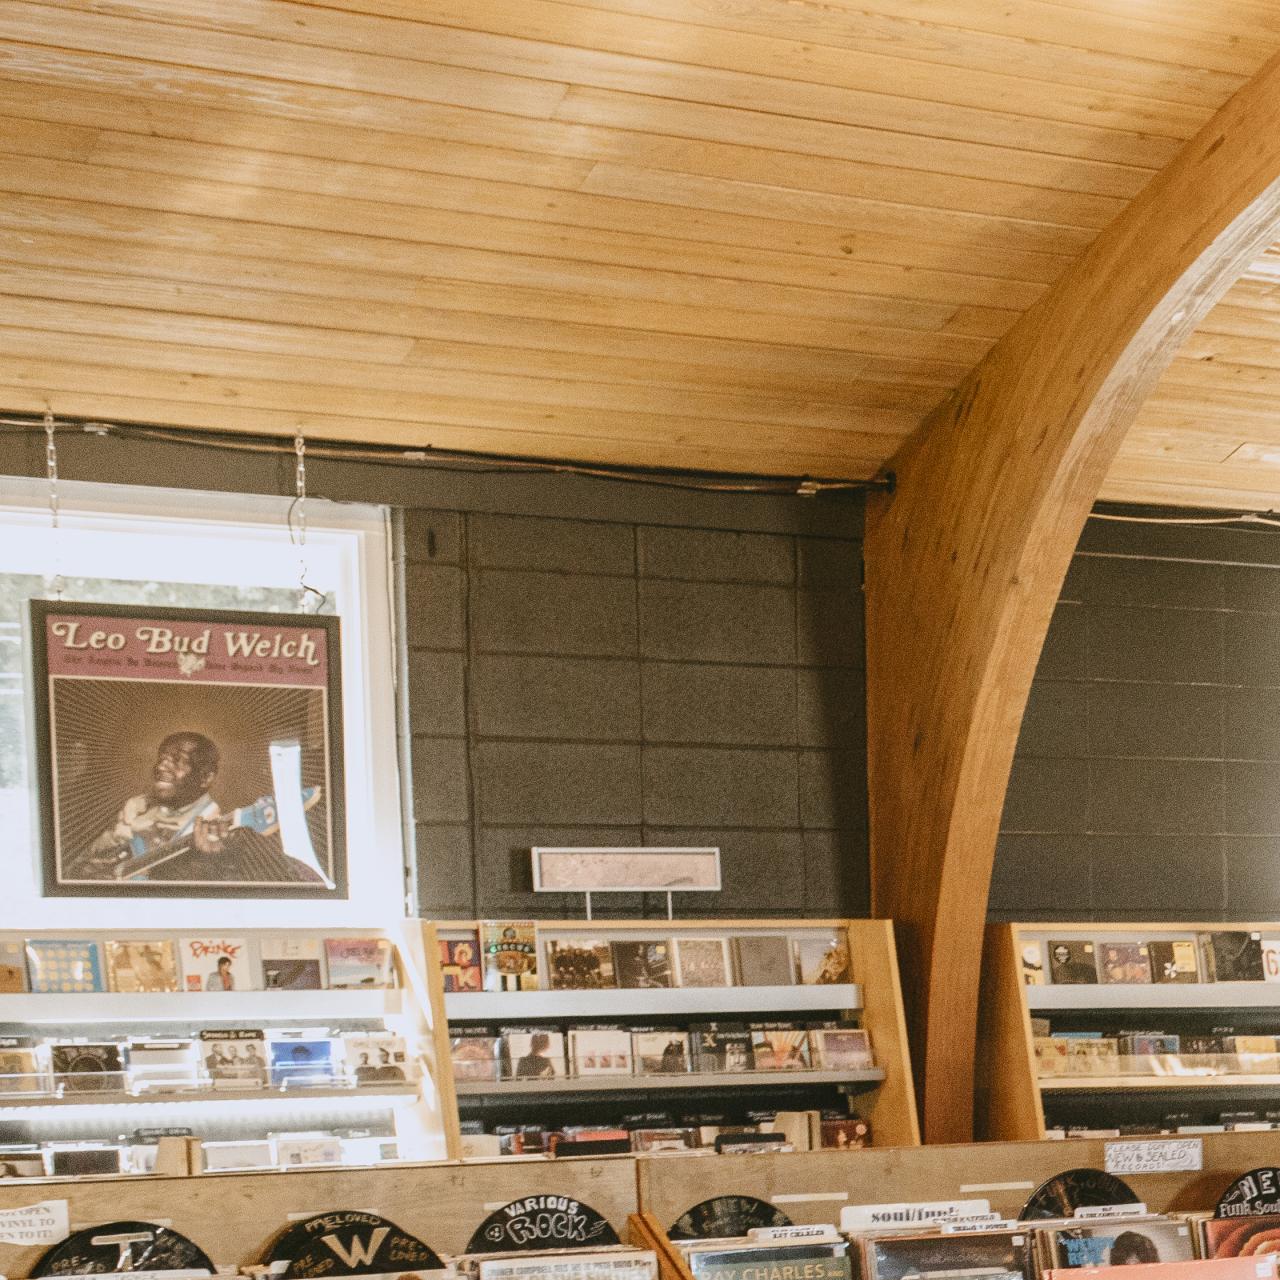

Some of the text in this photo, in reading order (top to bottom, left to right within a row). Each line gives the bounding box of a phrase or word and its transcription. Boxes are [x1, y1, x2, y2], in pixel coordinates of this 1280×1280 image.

[52, 621, 126, 651] Leo
[135, 626, 212, 654] Bud
[223, 631, 320, 666] Welch
[504, 1196, 580, 1218] VARIOUS
[507, 1213, 588, 1244] ROCK
[320, 1226, 389, 1268] W
